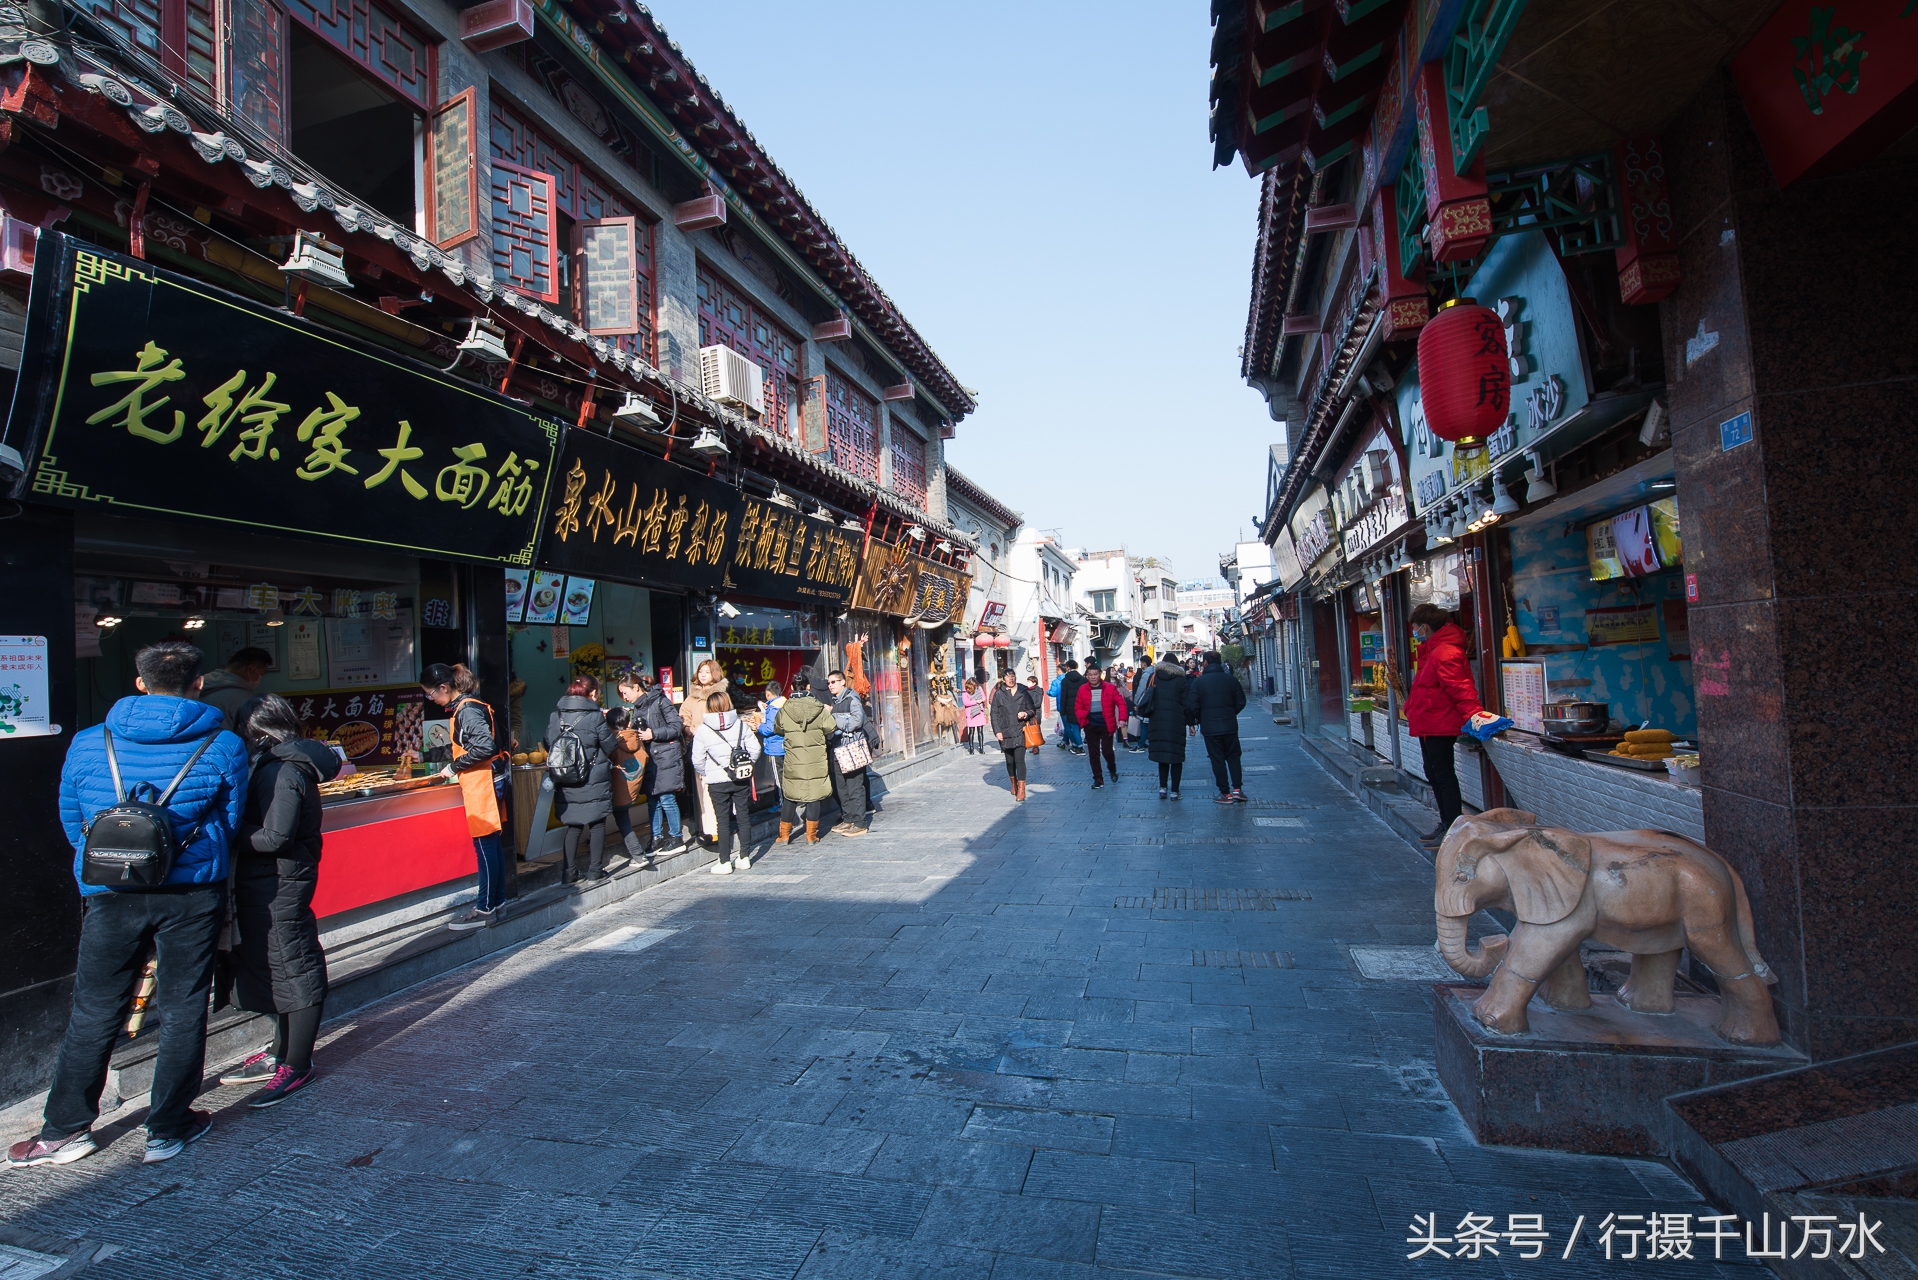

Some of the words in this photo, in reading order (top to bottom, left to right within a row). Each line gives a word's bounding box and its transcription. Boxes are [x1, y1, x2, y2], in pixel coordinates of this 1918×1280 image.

[1473, 313, 1509, 412] 客房
[85, 340, 540, 517] 老徐家大面筋
[1526, 374, 1562, 429] 冰沙
[1731, 428, 1740, 441] 72
[554, 456, 728, 566] 泉水山楂雪梨汤
[734, 500, 808, 577] 铁板鱿鱼
[0, 654, 43, 662] 系祖国未来
[0, 663, 43, 671] 爱未成年人
[290, 693, 386, 721] 家大面筋
